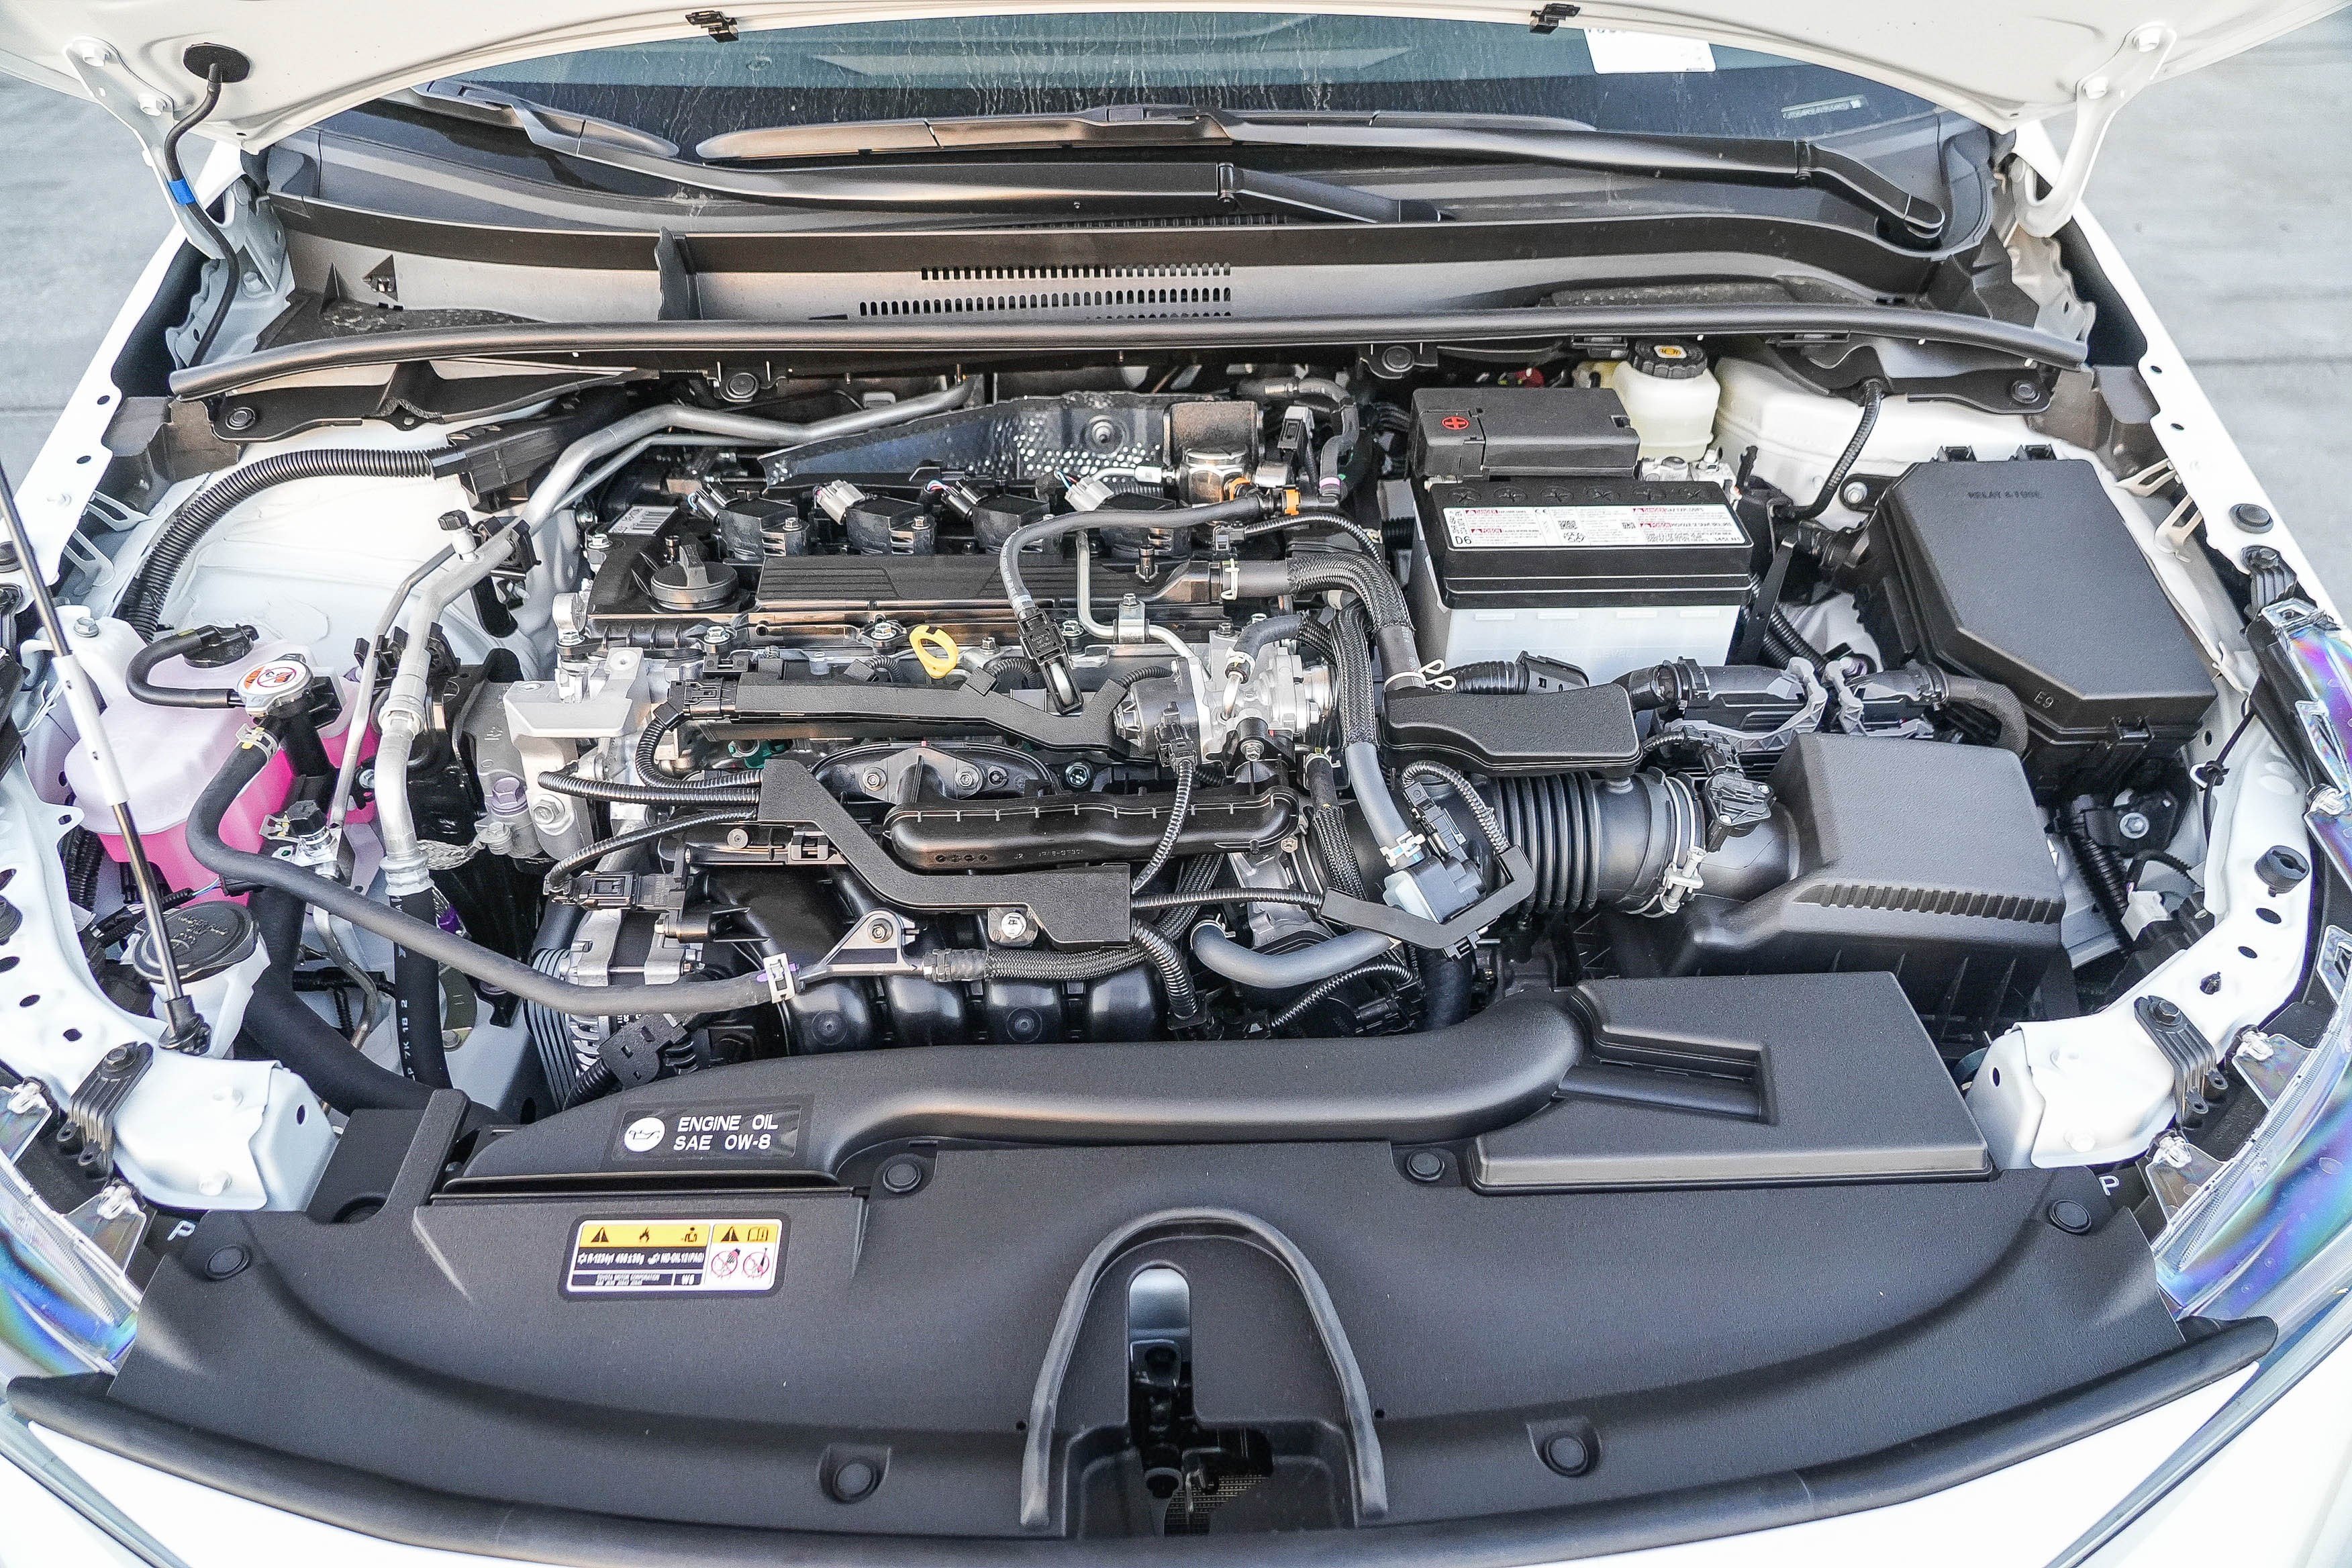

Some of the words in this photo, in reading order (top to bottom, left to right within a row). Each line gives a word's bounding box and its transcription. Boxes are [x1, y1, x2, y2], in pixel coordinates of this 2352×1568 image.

[1455, 536, 1472, 544] D6
[2034, 691, 2053, 709] E9
[401, 999, 407, 1008] 2
[677, 1115, 742, 1132] ENGINE
[752, 1114, 779, 1130] OIL
[673, 1134, 713, 1150] SAE
[2098, 1175, 2119, 1196] P
[167, 1220, 196, 1241] P
